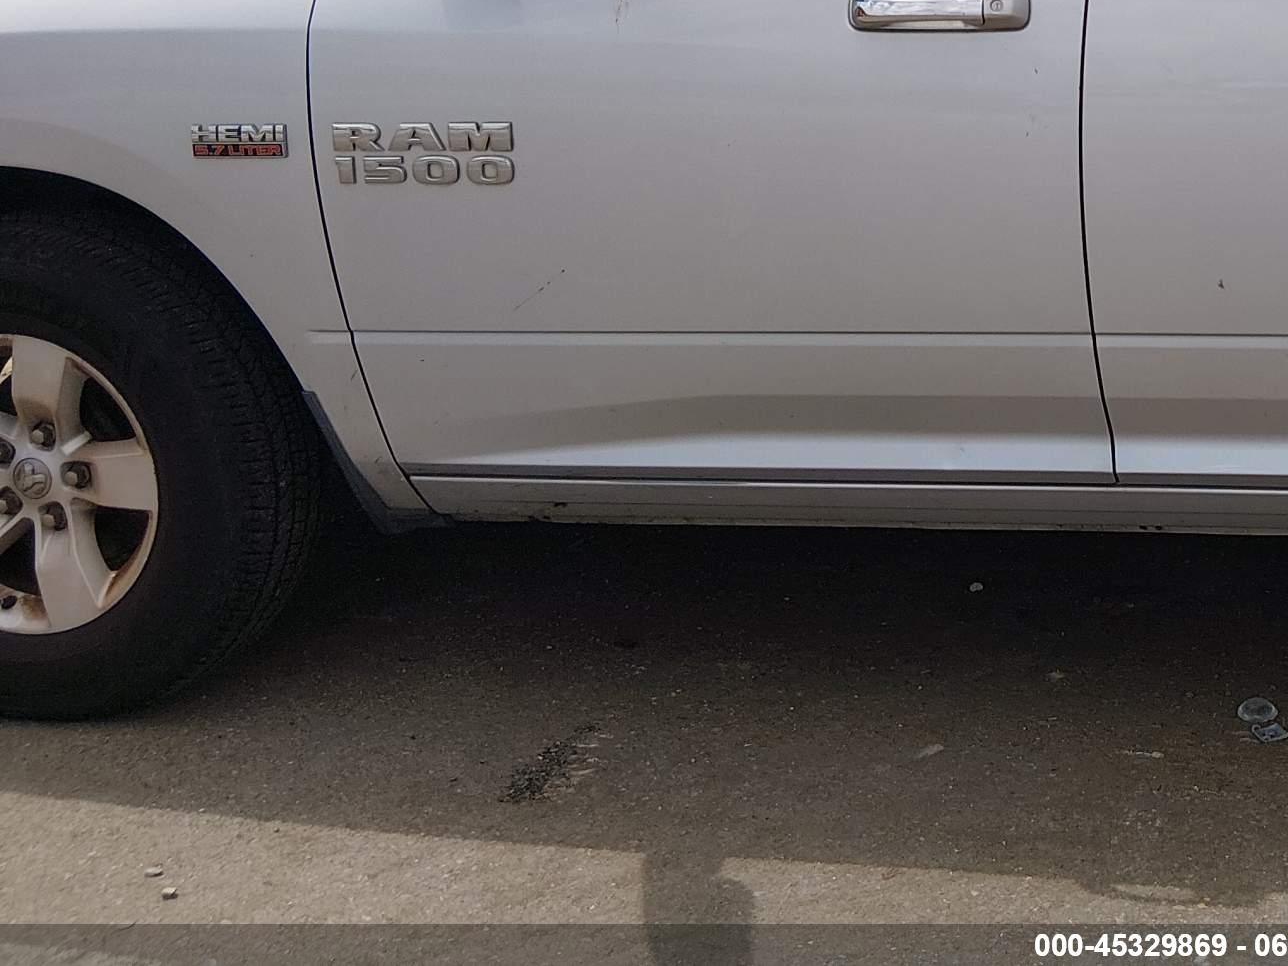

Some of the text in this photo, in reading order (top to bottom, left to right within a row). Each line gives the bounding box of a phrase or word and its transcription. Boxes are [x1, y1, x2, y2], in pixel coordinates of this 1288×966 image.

[191, 123, 285, 143] HEMI
[331, 121, 514, 152] RAM
[194, 144, 282, 156] 5.7 LITER
[333, 155, 515, 185] 1500
